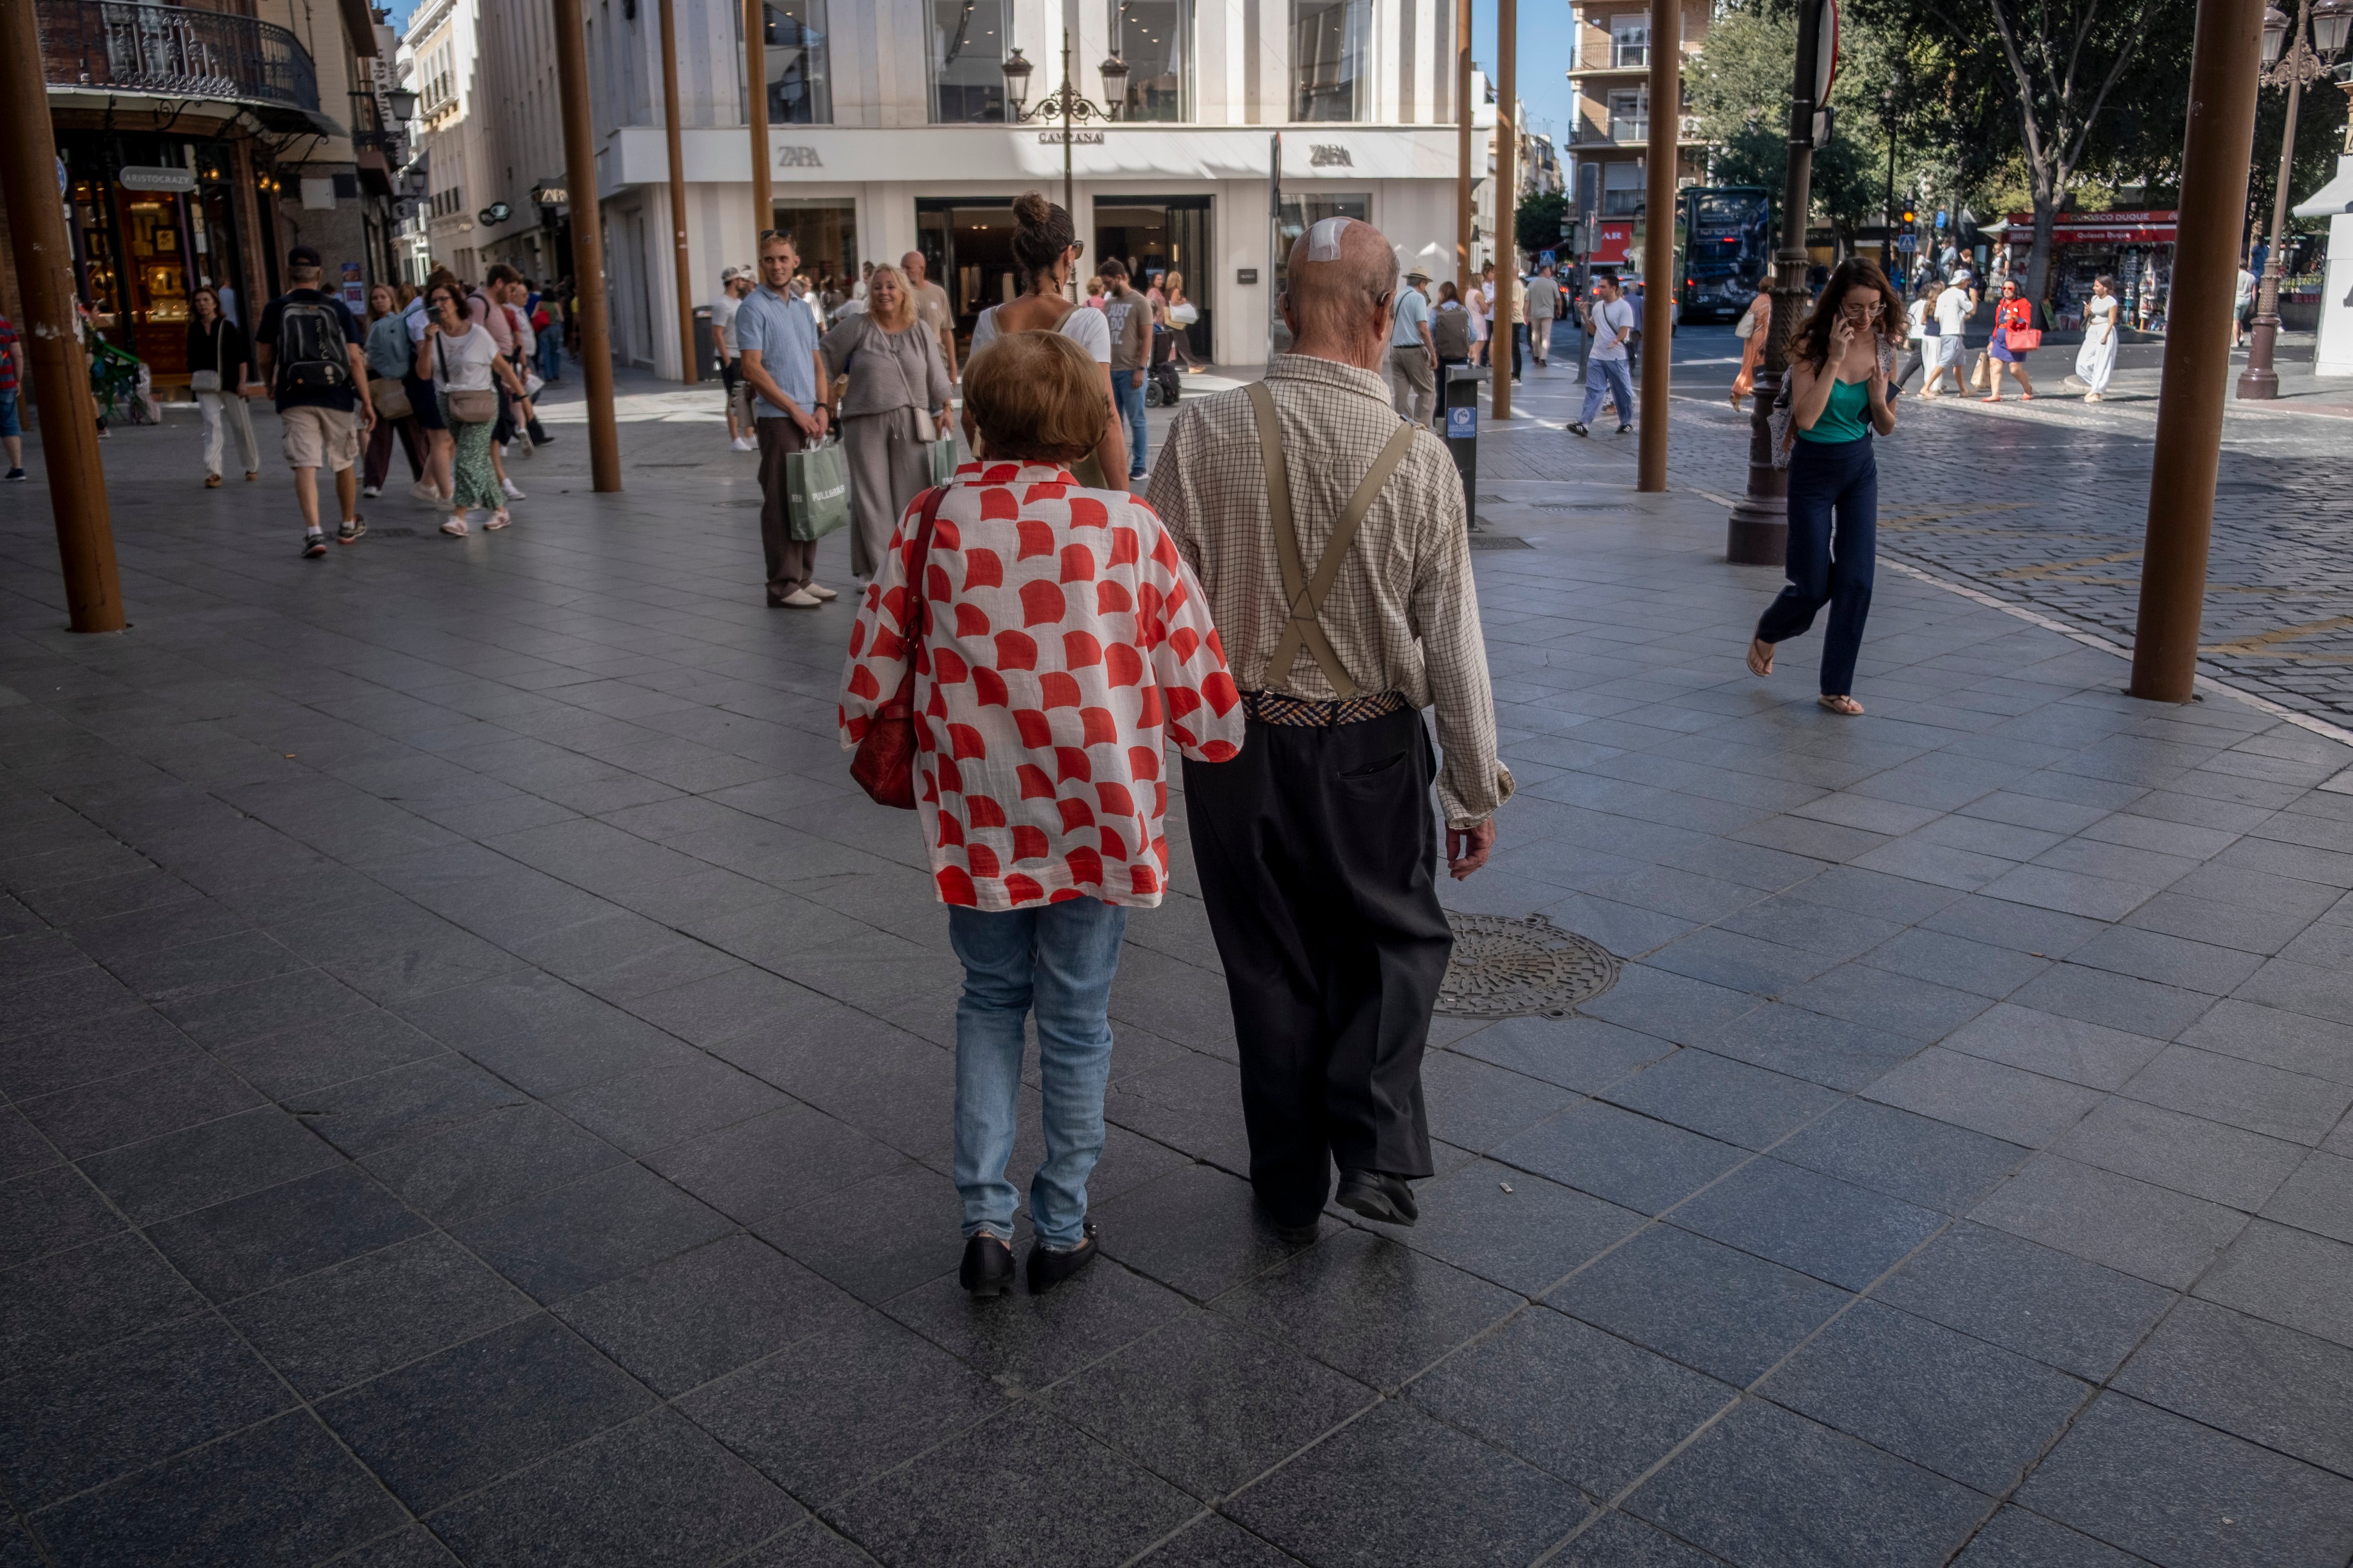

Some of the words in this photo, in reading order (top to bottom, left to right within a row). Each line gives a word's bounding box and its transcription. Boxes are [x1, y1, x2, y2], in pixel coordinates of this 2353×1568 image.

[1038, 132, 1101, 142] CAMANA
[778, 146, 824, 167] ZARA
[1309, 144, 1354, 167] ZARA
[125, 174, 189, 184] ARISTOCRAZY
[813, 485, 845, 502] PULL&BAR
